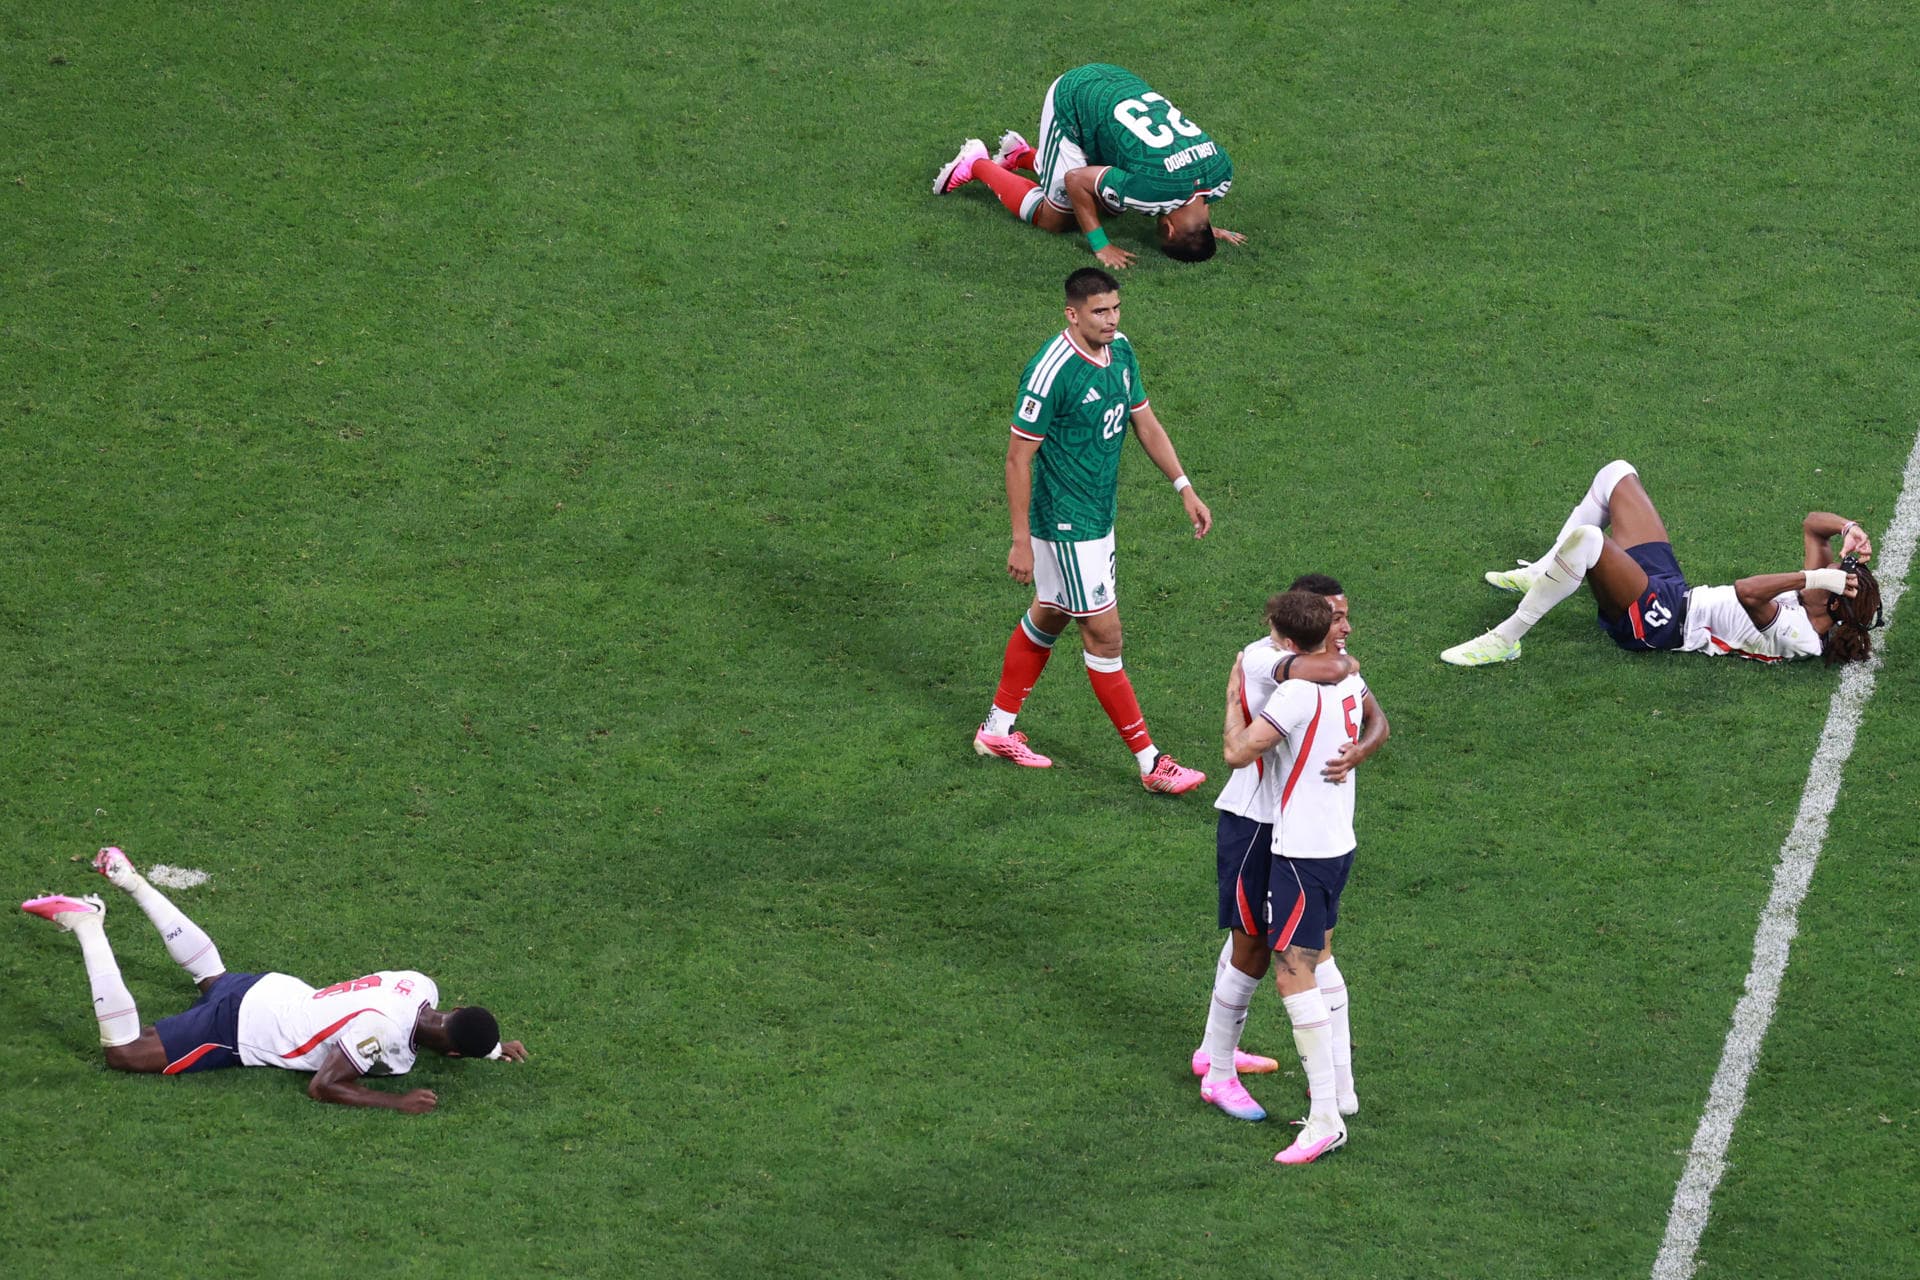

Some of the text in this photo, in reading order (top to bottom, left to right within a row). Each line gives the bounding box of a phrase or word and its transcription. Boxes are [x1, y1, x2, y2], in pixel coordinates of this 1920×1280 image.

[1114, 92, 1202, 148] 23
[1103, 403, 1125, 440] 22
[1645, 600, 1672, 628] 25
[1342, 694, 1358, 745] 5
